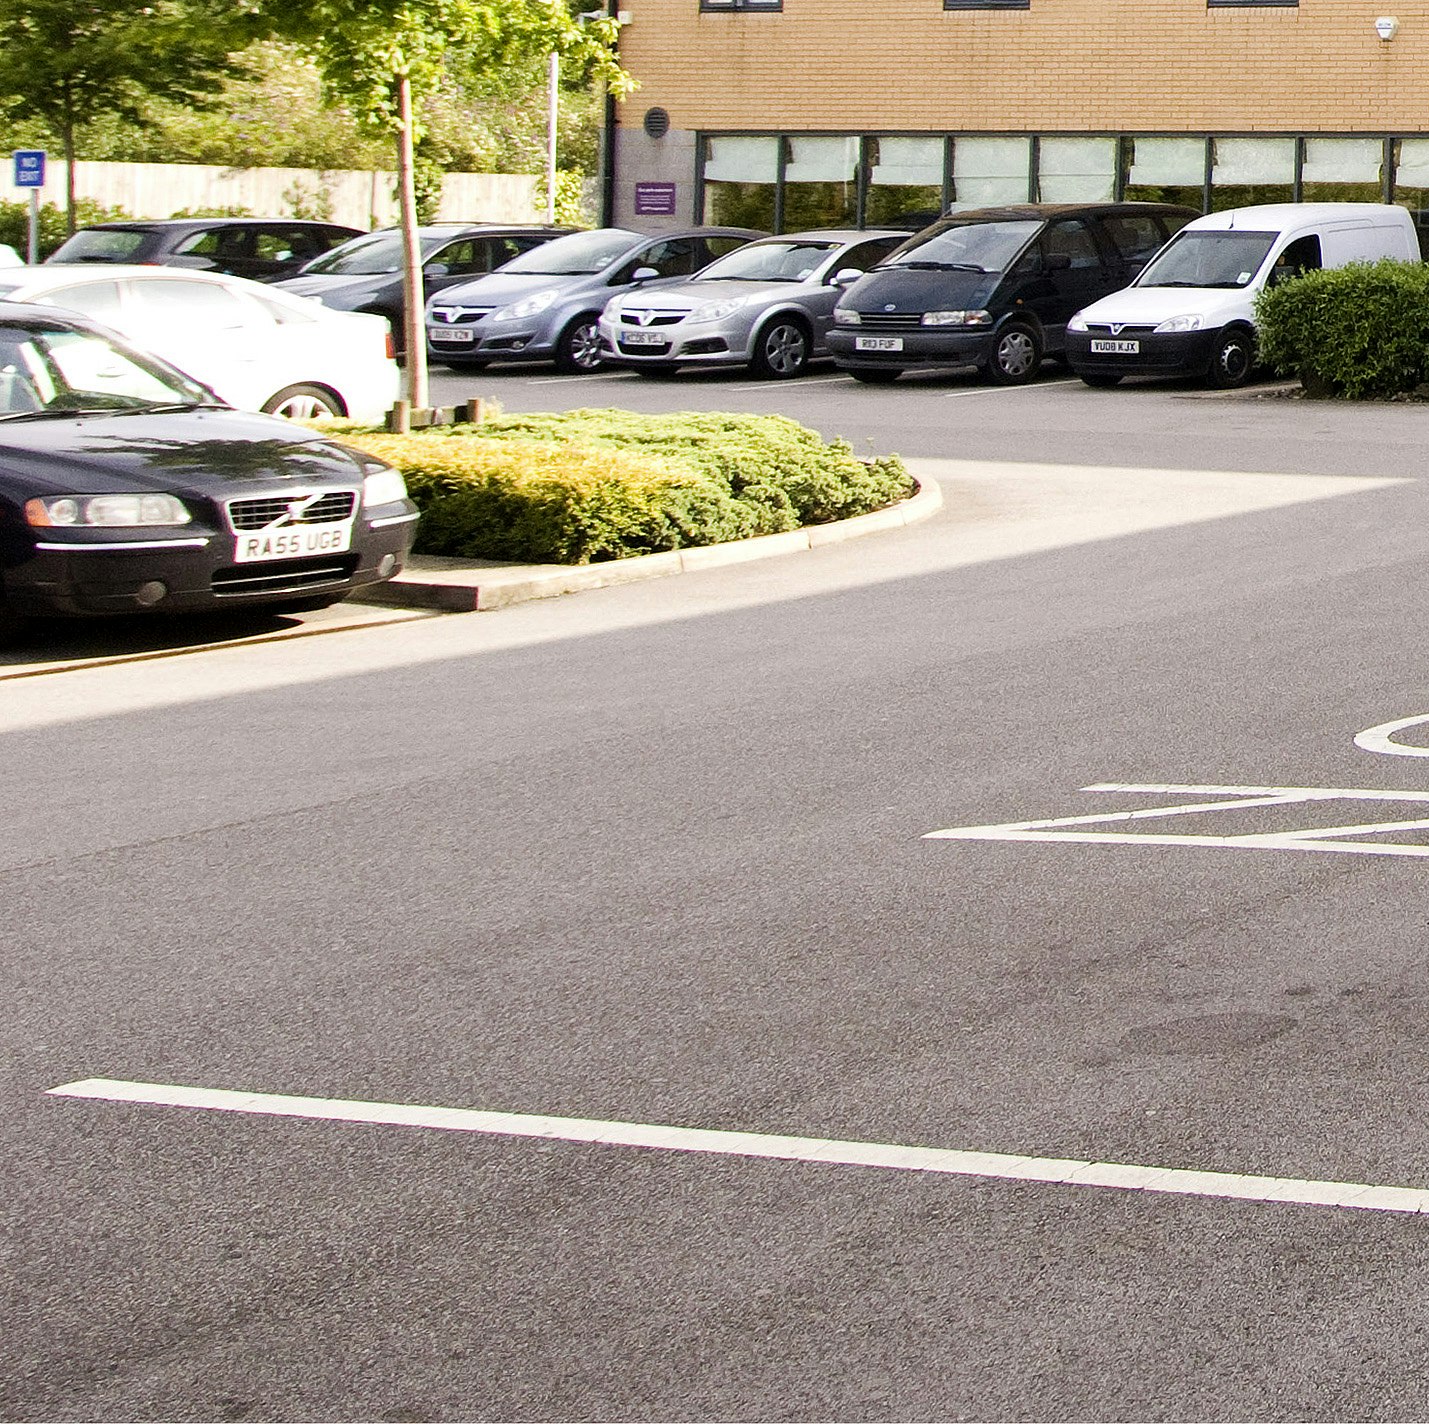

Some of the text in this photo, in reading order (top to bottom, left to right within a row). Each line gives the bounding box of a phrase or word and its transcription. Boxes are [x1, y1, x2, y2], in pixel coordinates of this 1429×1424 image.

[1117, 342, 1136, 352] KJX
[247, 530, 343, 557] RA55 UGB
